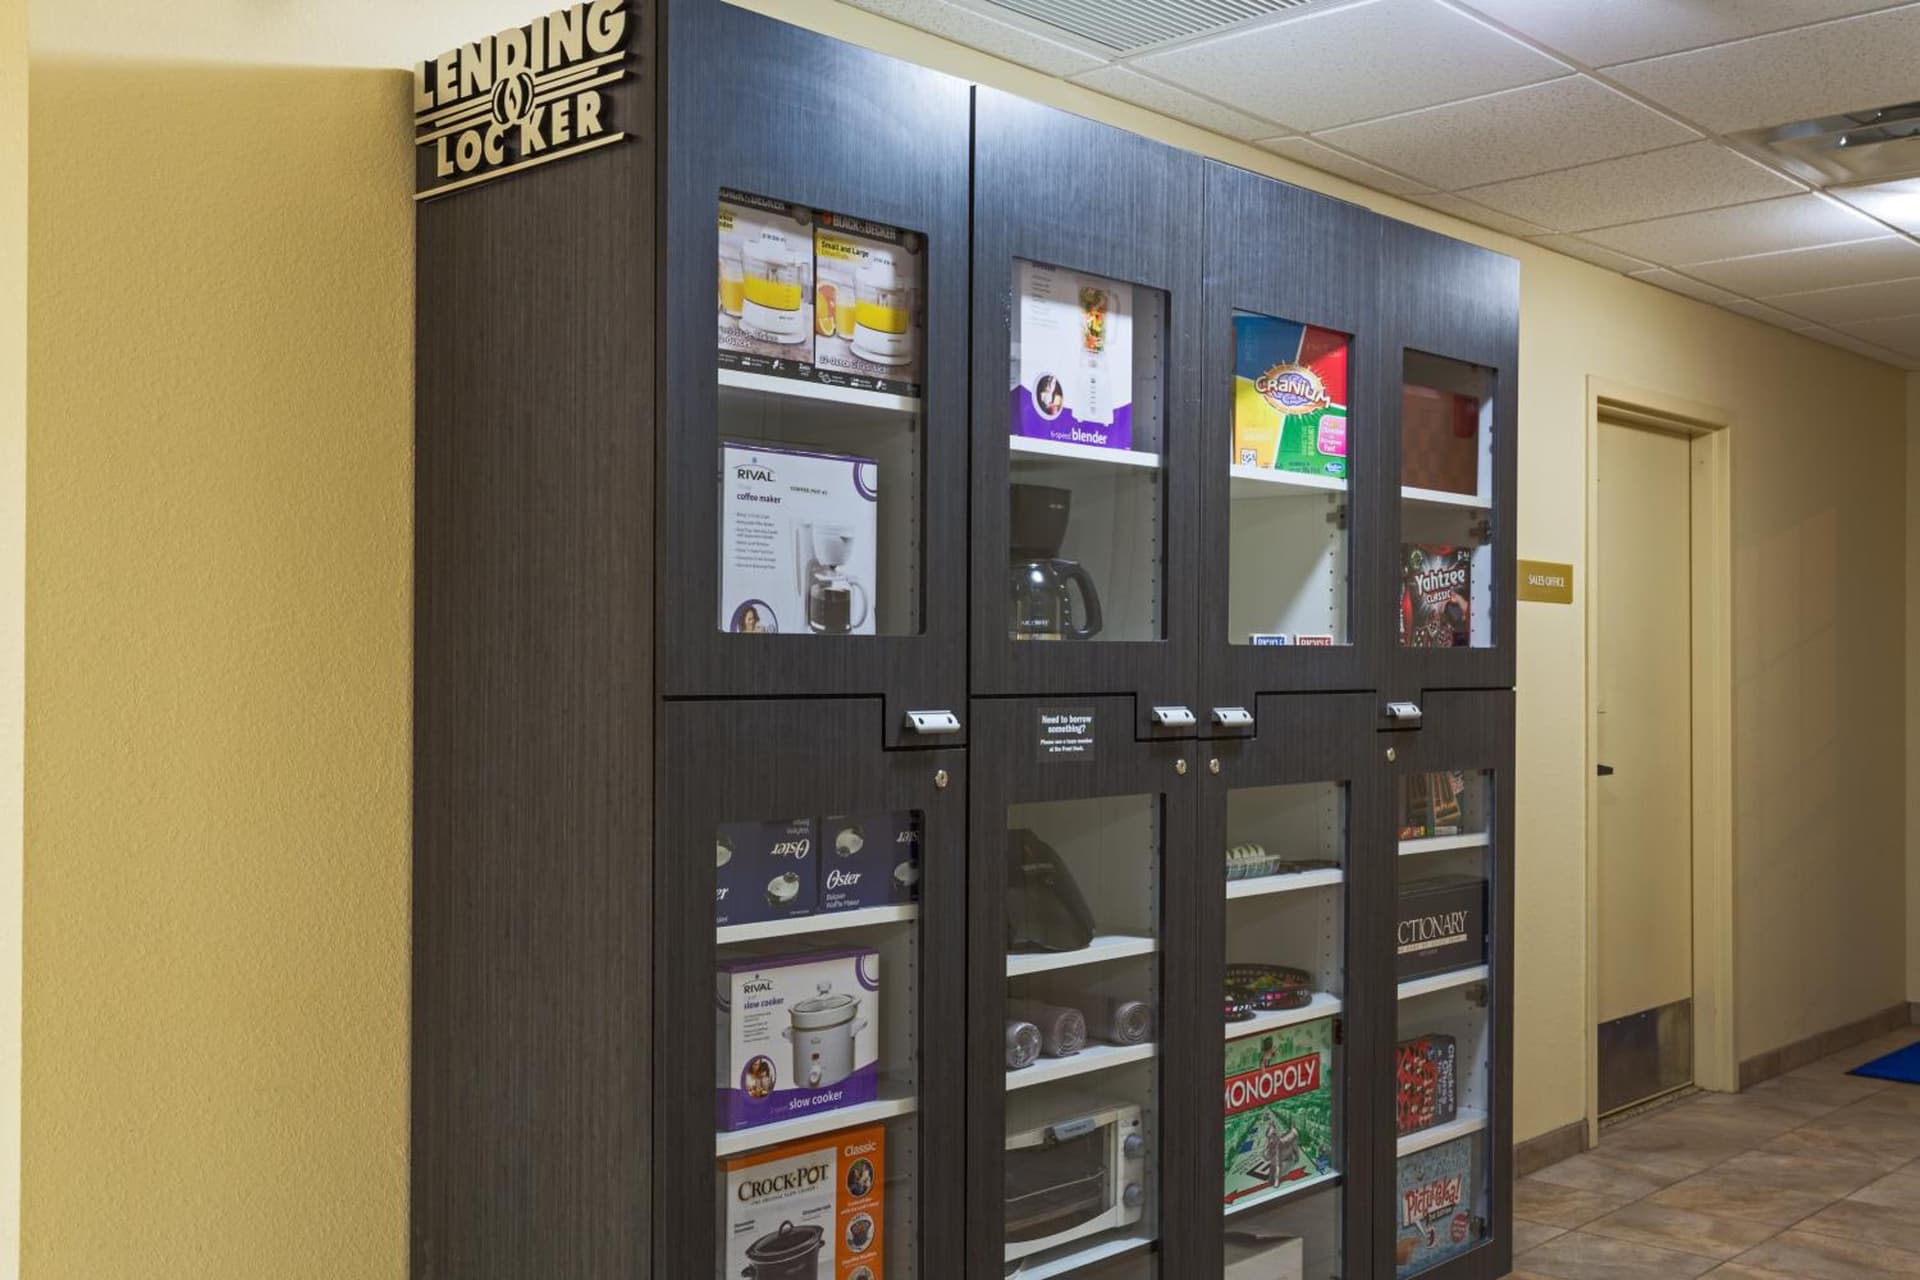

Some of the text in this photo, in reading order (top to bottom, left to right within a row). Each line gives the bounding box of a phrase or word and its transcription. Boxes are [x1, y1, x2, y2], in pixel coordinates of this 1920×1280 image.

[414, 0, 627, 114] LENDING
[852, 247, 869, 258] Large
[1071, 427, 1108, 445] blender
[737, 468, 773, 482] RIVAL
[736, 491, 782, 504] coffee maker
[1414, 568, 1466, 597] Yahtzee
[1528, 574, 1565, 588] SALES OFFICE
[1426, 590, 1451, 604] CLASSIC
[1041, 715, 1092, 724] Need to borrow
[769, 838, 810, 860] Oster
[826, 868, 862, 890] Oster
[743, 982, 773, 994] RIVAL
[744, 997, 785, 1010] slow cooker
[789, 1097, 811, 1111] slow
[811, 1090, 844, 1106] cooker
[844, 1140, 878, 1157] Classic
